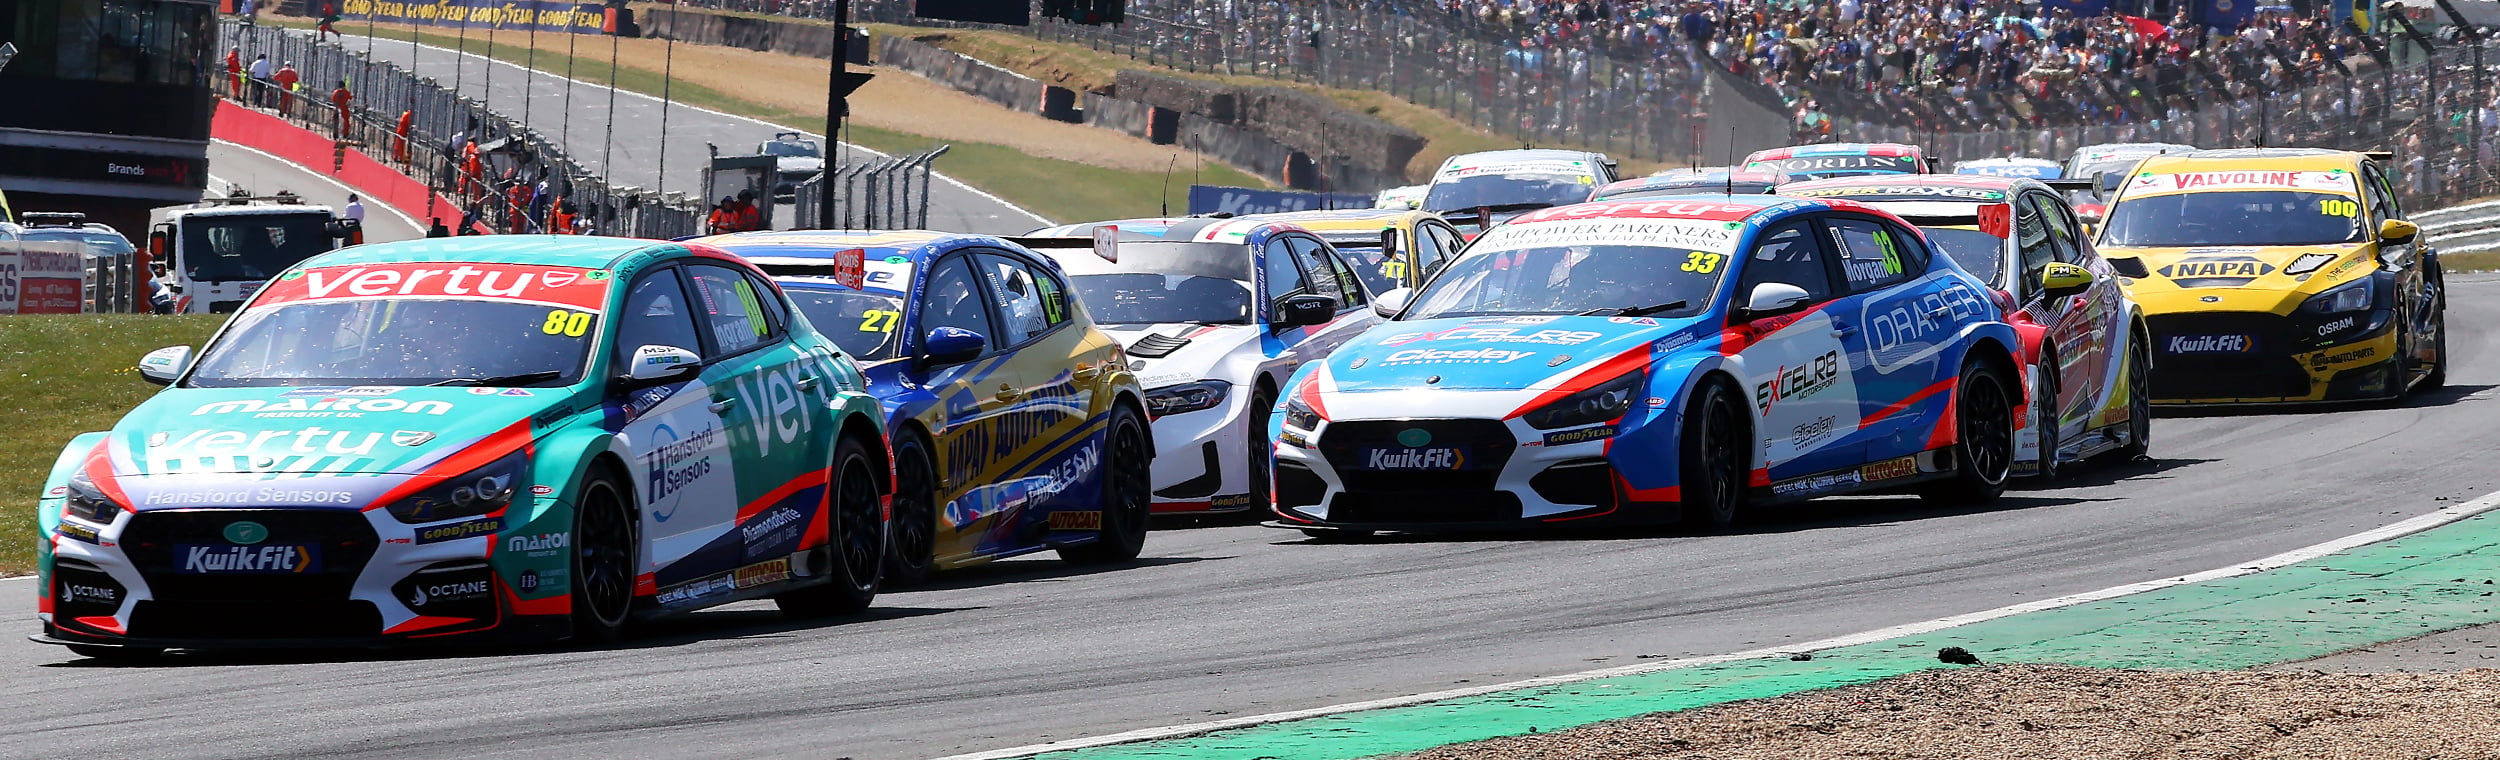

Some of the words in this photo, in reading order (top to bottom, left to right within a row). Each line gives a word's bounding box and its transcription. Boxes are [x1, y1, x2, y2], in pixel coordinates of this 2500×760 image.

[108, 163, 145, 176] Brands
[2174, 171, 2301, 189] VALVOLINE
[2319, 199, 2357, 218] 100
[1609, 224, 1733, 242] PARTNERS
[1641, 235, 1721, 249] PLANNING
[839, 253, 860, 268] Vans
[1382, 261, 1405, 279] 77
[1680, 251, 1721, 275] 33
[2178, 263, 2256, 278] NAPA
[1842, 258, 1890, 285] Morgan
[542, 310, 592, 337] 80
[859, 310, 899, 333] 27
[2318, 316, 2354, 336] OSRAM
[712, 317, 759, 349] Ingram
[1656, 332, 1693, 353] Dynamics
[1757, 349, 1838, 417] EXCELR8
[1550, 427, 1614, 444] GOODYEAR
[1792, 415, 1836, 445] Ciceley
[665, 421, 714, 470] Hansford
[666, 455, 711, 495] Sensors
[1866, 457, 1914, 481] AUTOCAR
[145, 487, 250, 506] Hansford
[257, 487, 352, 504] Sensors
[424, 520, 498, 540] GOODYEAR
[742, 507, 801, 545] Diamondbrite
[738, 559, 785, 587] AUTOCAR
[73, 585, 115, 600] OCTANE
[430, 580, 488, 598] OCTANE
